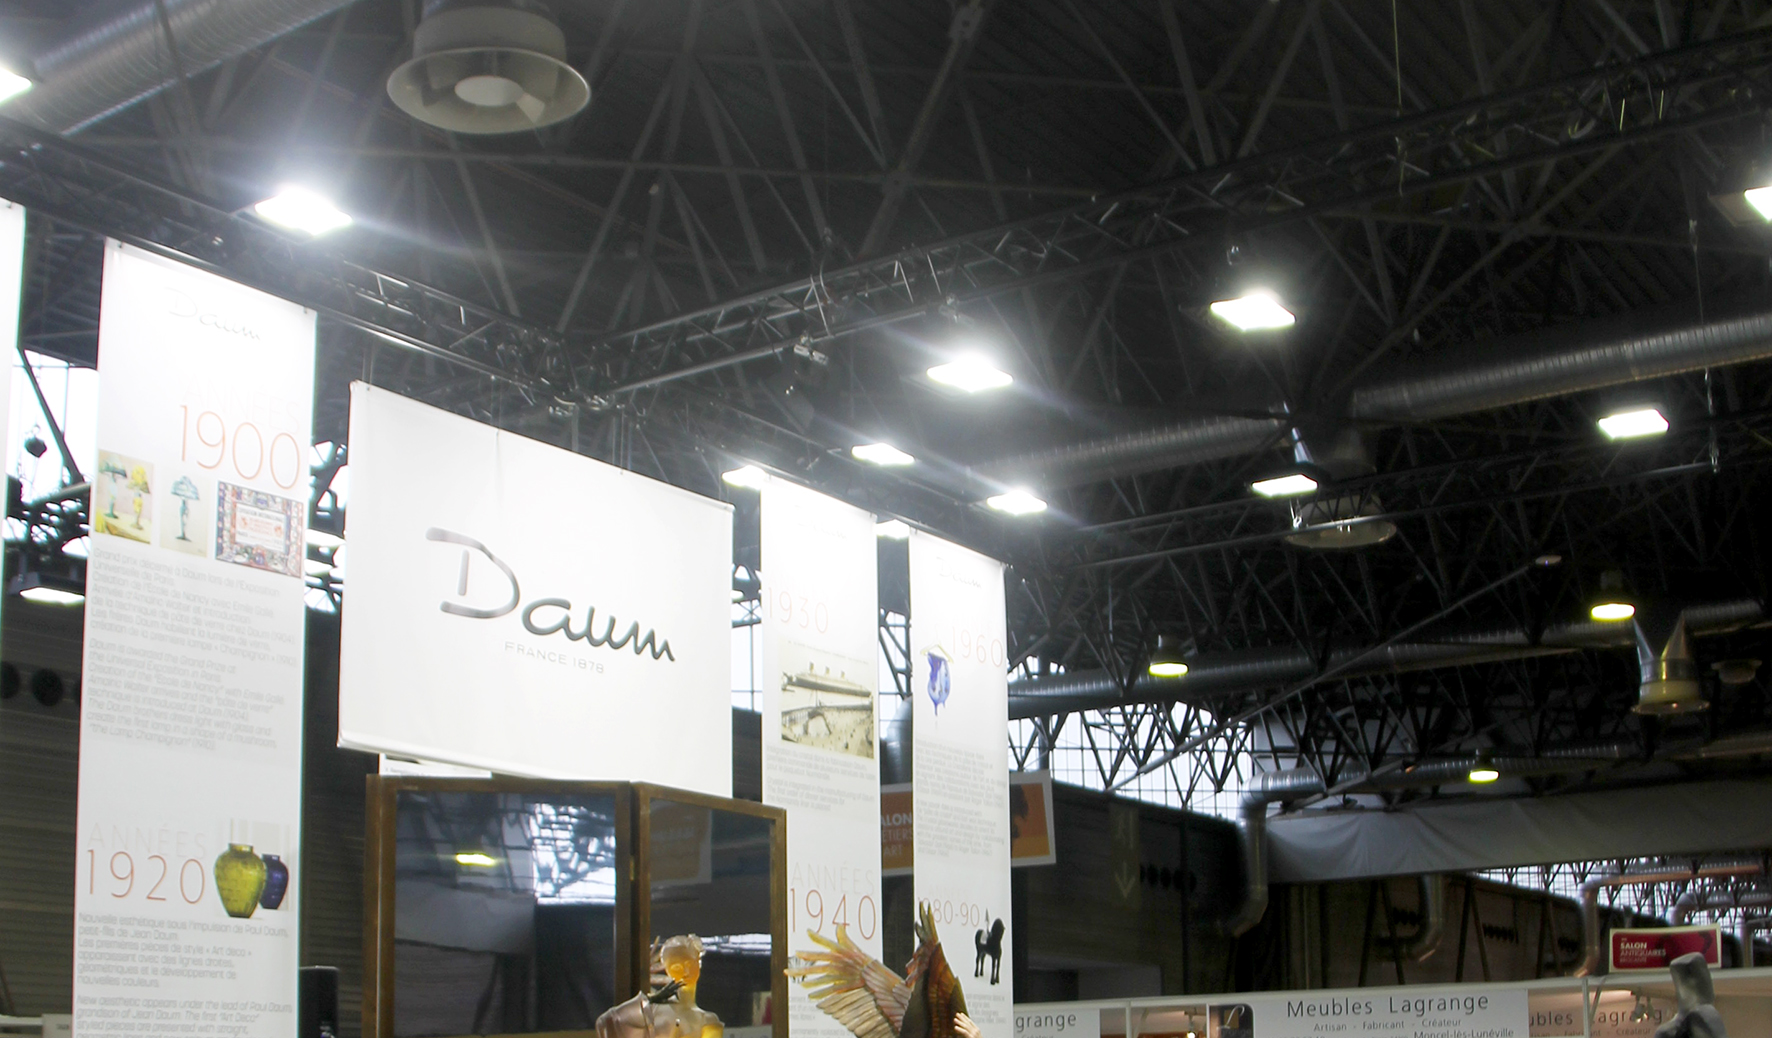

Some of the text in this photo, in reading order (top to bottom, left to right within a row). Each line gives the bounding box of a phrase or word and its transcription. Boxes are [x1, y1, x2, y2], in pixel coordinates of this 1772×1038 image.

[165, 287, 260, 341] Daum
[180, 405, 301, 490] 1900
[425, 527, 675, 662] Daum
[768, 587, 829, 634] 1930
[505, 641, 604, 674] FRANCE 1878
[951, 625, 1004, 667] 1960
[87, 849, 205, 904] 1920
[789, 888, 876, 940] 1940
[918, 897, 980, 928] 80-90
[1620, 942, 1647, 950] SALON
[1015, 1013, 1077, 1033] grange
[1287, 995, 1489, 1018] Meubles Lagrange
[1314, 1022, 1347, 1032] Artisan
[1363, 1020, 1405, 1030] Fabricant
[1422, 1017, 1461, 1028] Créateur
